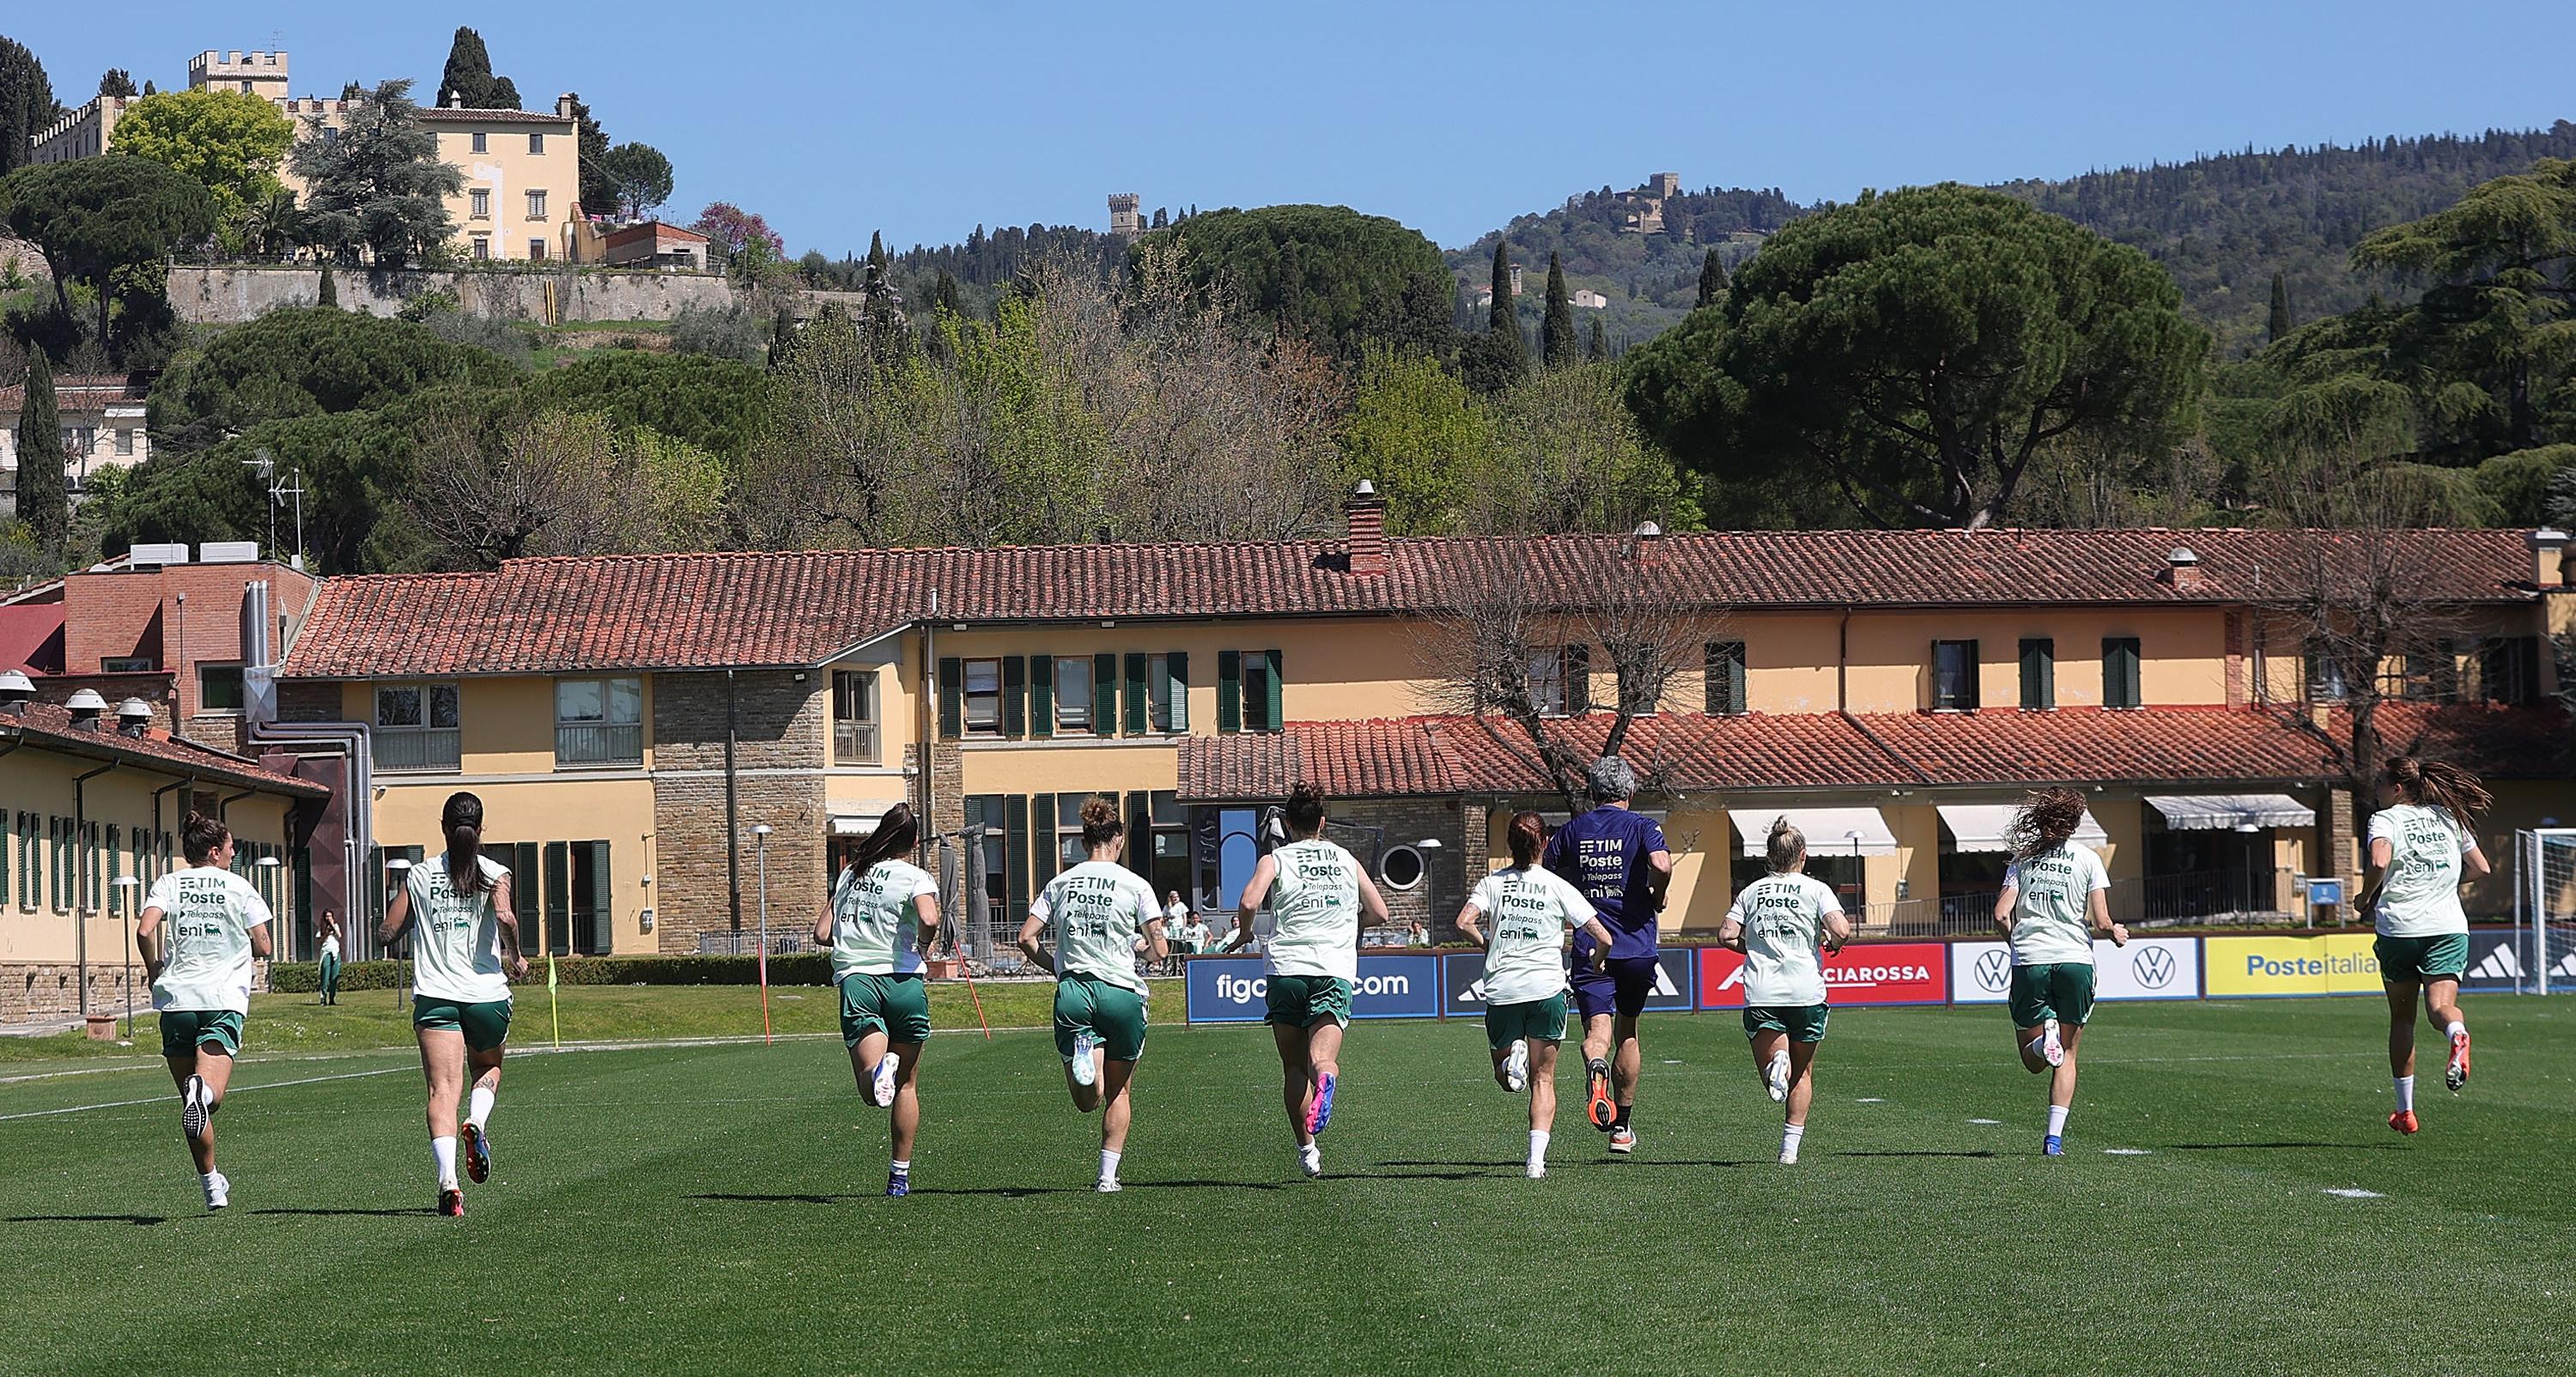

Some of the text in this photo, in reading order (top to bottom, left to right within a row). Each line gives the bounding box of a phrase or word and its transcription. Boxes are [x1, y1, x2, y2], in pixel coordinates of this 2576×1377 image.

[2417, 816, 2441, 828] TIM
[2407, 832, 2446, 845] Poste
[1595, 839, 1622, 852] TIM
[1314, 848, 1339, 862] TIM
[1580, 854, 1623, 868] Poste
[1298, 864, 1341, 878] Poste
[2032, 860, 2072, 875] Poste
[2415, 859, 2434, 872] eni
[198, 877, 226, 889] TIM
[1587, 872, 1623, 882] Telepass
[2037, 877, 2069, 888] Telepass
[1087, 877, 1116, 891] TIM
[1309, 883, 1343, 892] Telepass
[1521, 881, 1546, 895] TIM
[1774, 883, 1801, 895] TIM
[1583, 884, 1604, 898] eni
[2028, 889, 2049, 901] eni
[179, 891, 226, 905] Poste
[1066, 890, 1113, 907] Poste
[1301, 895, 1323, 908] eni
[1502, 895, 1545, 911] Poste
[1757, 897, 1799, 908] Poste
[186, 910, 225, 919] Telepass
[440, 906, 473, 914] Teepass
[1073, 910, 1109, 921] Telepass
[434, 917, 453, 933] eni
[1507, 913, 1542, 925] Telepass
[179, 923, 203, 937] eni
[1067, 924, 1089, 937] eni
[1500, 927, 1521, 939] eni
[1758, 925, 1778, 939] eni
[2246, 952, 2380, 976] Posteitalia
[1822, 965, 1929, 982] CIAROSSA
